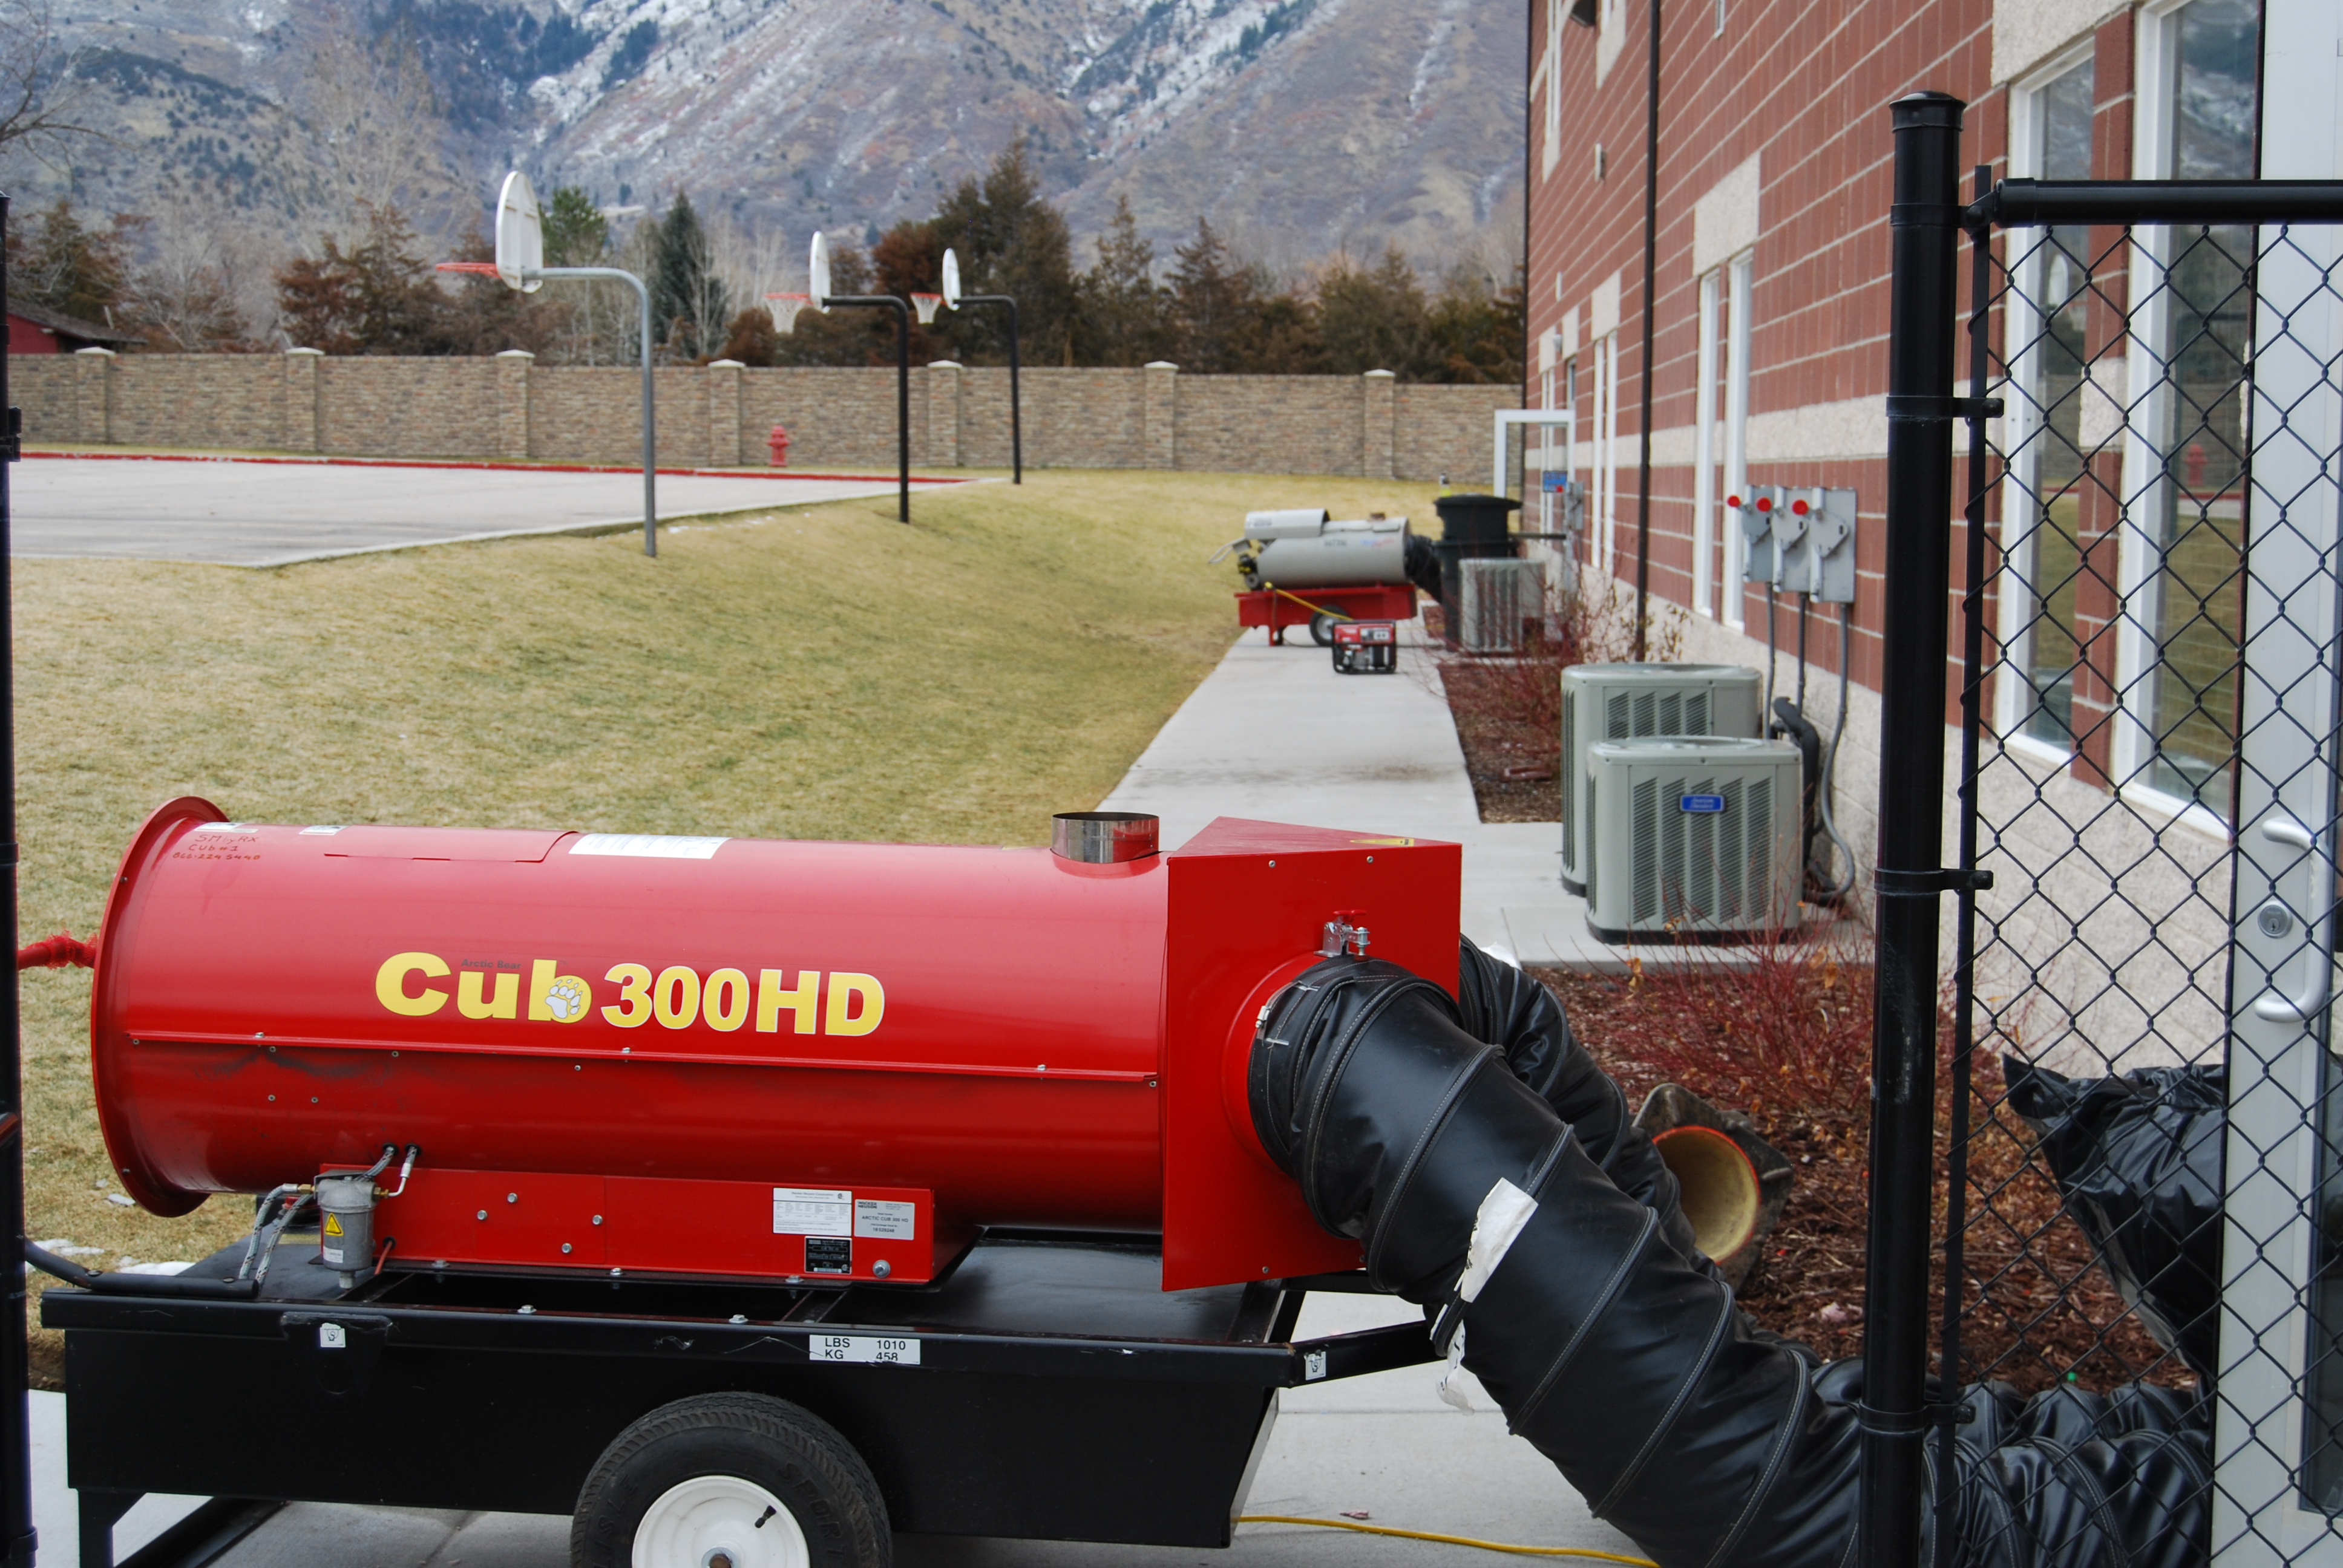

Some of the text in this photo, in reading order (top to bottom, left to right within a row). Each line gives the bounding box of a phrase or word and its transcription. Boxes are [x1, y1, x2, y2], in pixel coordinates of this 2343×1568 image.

[461, 959, 522, 969] Arctic Bear
[375, 951, 885, 1037] Cub 300HD
[825, 1337, 906, 1350] LBS 1010
[825, 1350, 898, 1361] KG 458
[778, 1463, 845, 1560] SPORT
